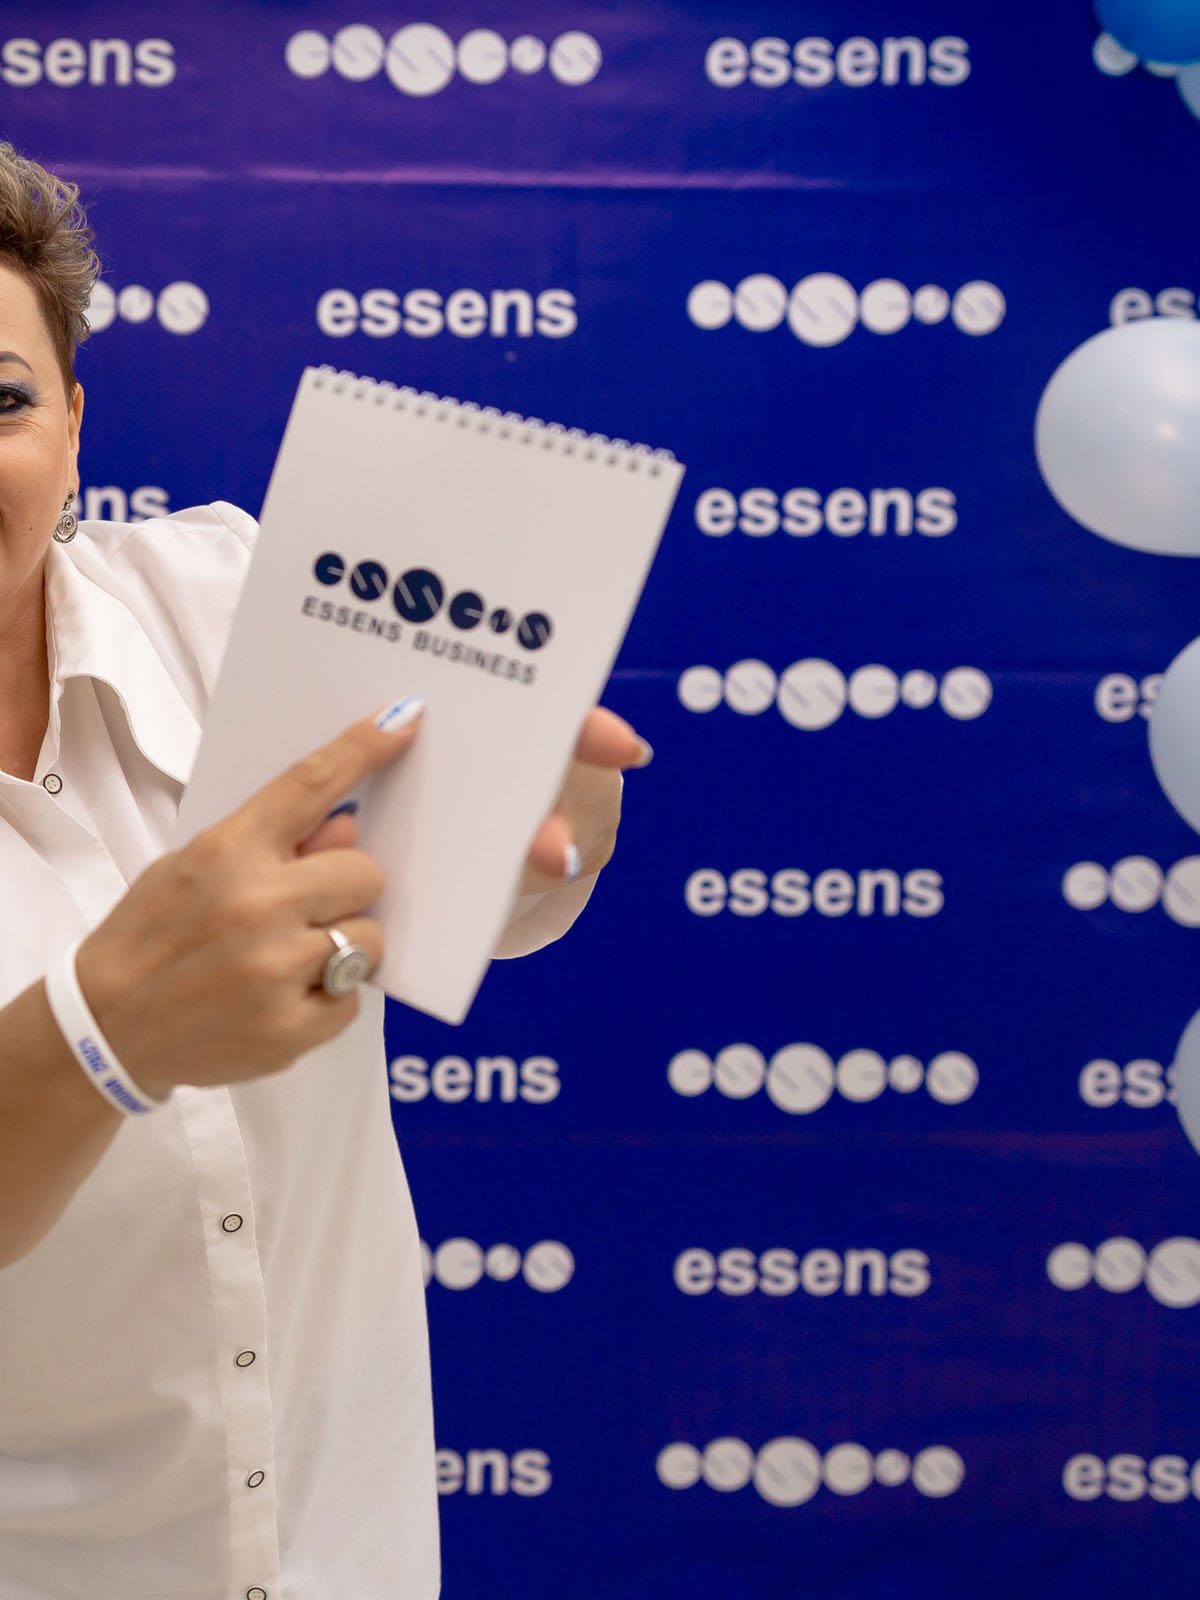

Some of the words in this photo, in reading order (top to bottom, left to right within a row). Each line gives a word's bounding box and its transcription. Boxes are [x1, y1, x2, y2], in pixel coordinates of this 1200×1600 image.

[705, 38, 969, 87] essens
[316, 288, 578, 338] essens
[695, 488, 957, 536] essens
[301, 596, 403, 644] ESSENS
[412, 630, 538, 686] BUSINESS
[685, 869, 943, 916] essens
[389, 1056, 561, 1103] sens
[674, 1248, 930, 1296] essens
[434, 1448, 552, 1496] ens
[1063, 1453, 1200, 1502] ess
